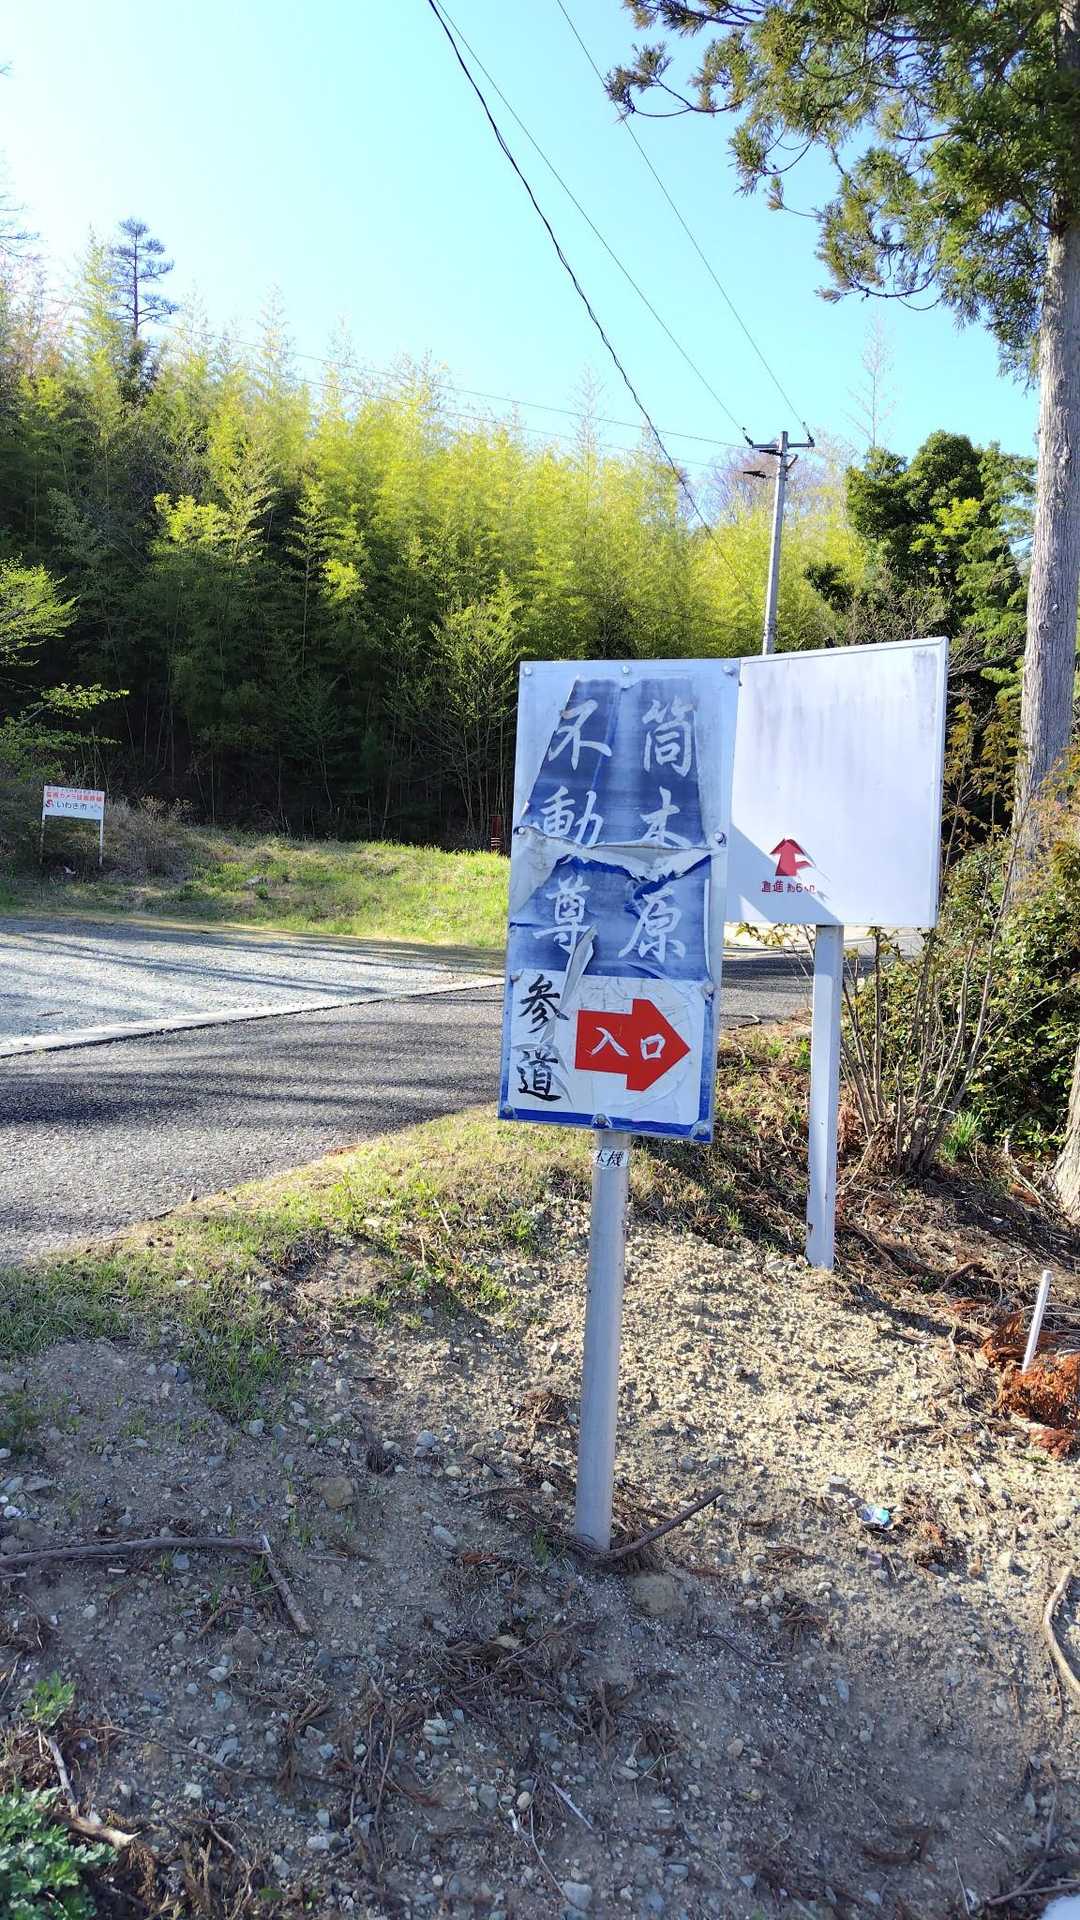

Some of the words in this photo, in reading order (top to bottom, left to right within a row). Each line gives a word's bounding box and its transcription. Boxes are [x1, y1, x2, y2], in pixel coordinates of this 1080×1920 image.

[531, 697, 613, 953] 不動尊
[761, 880, 784, 893] 直進
[516, 972, 570, 1102] 参道
[591, 1025, 665, 1060] 入口
